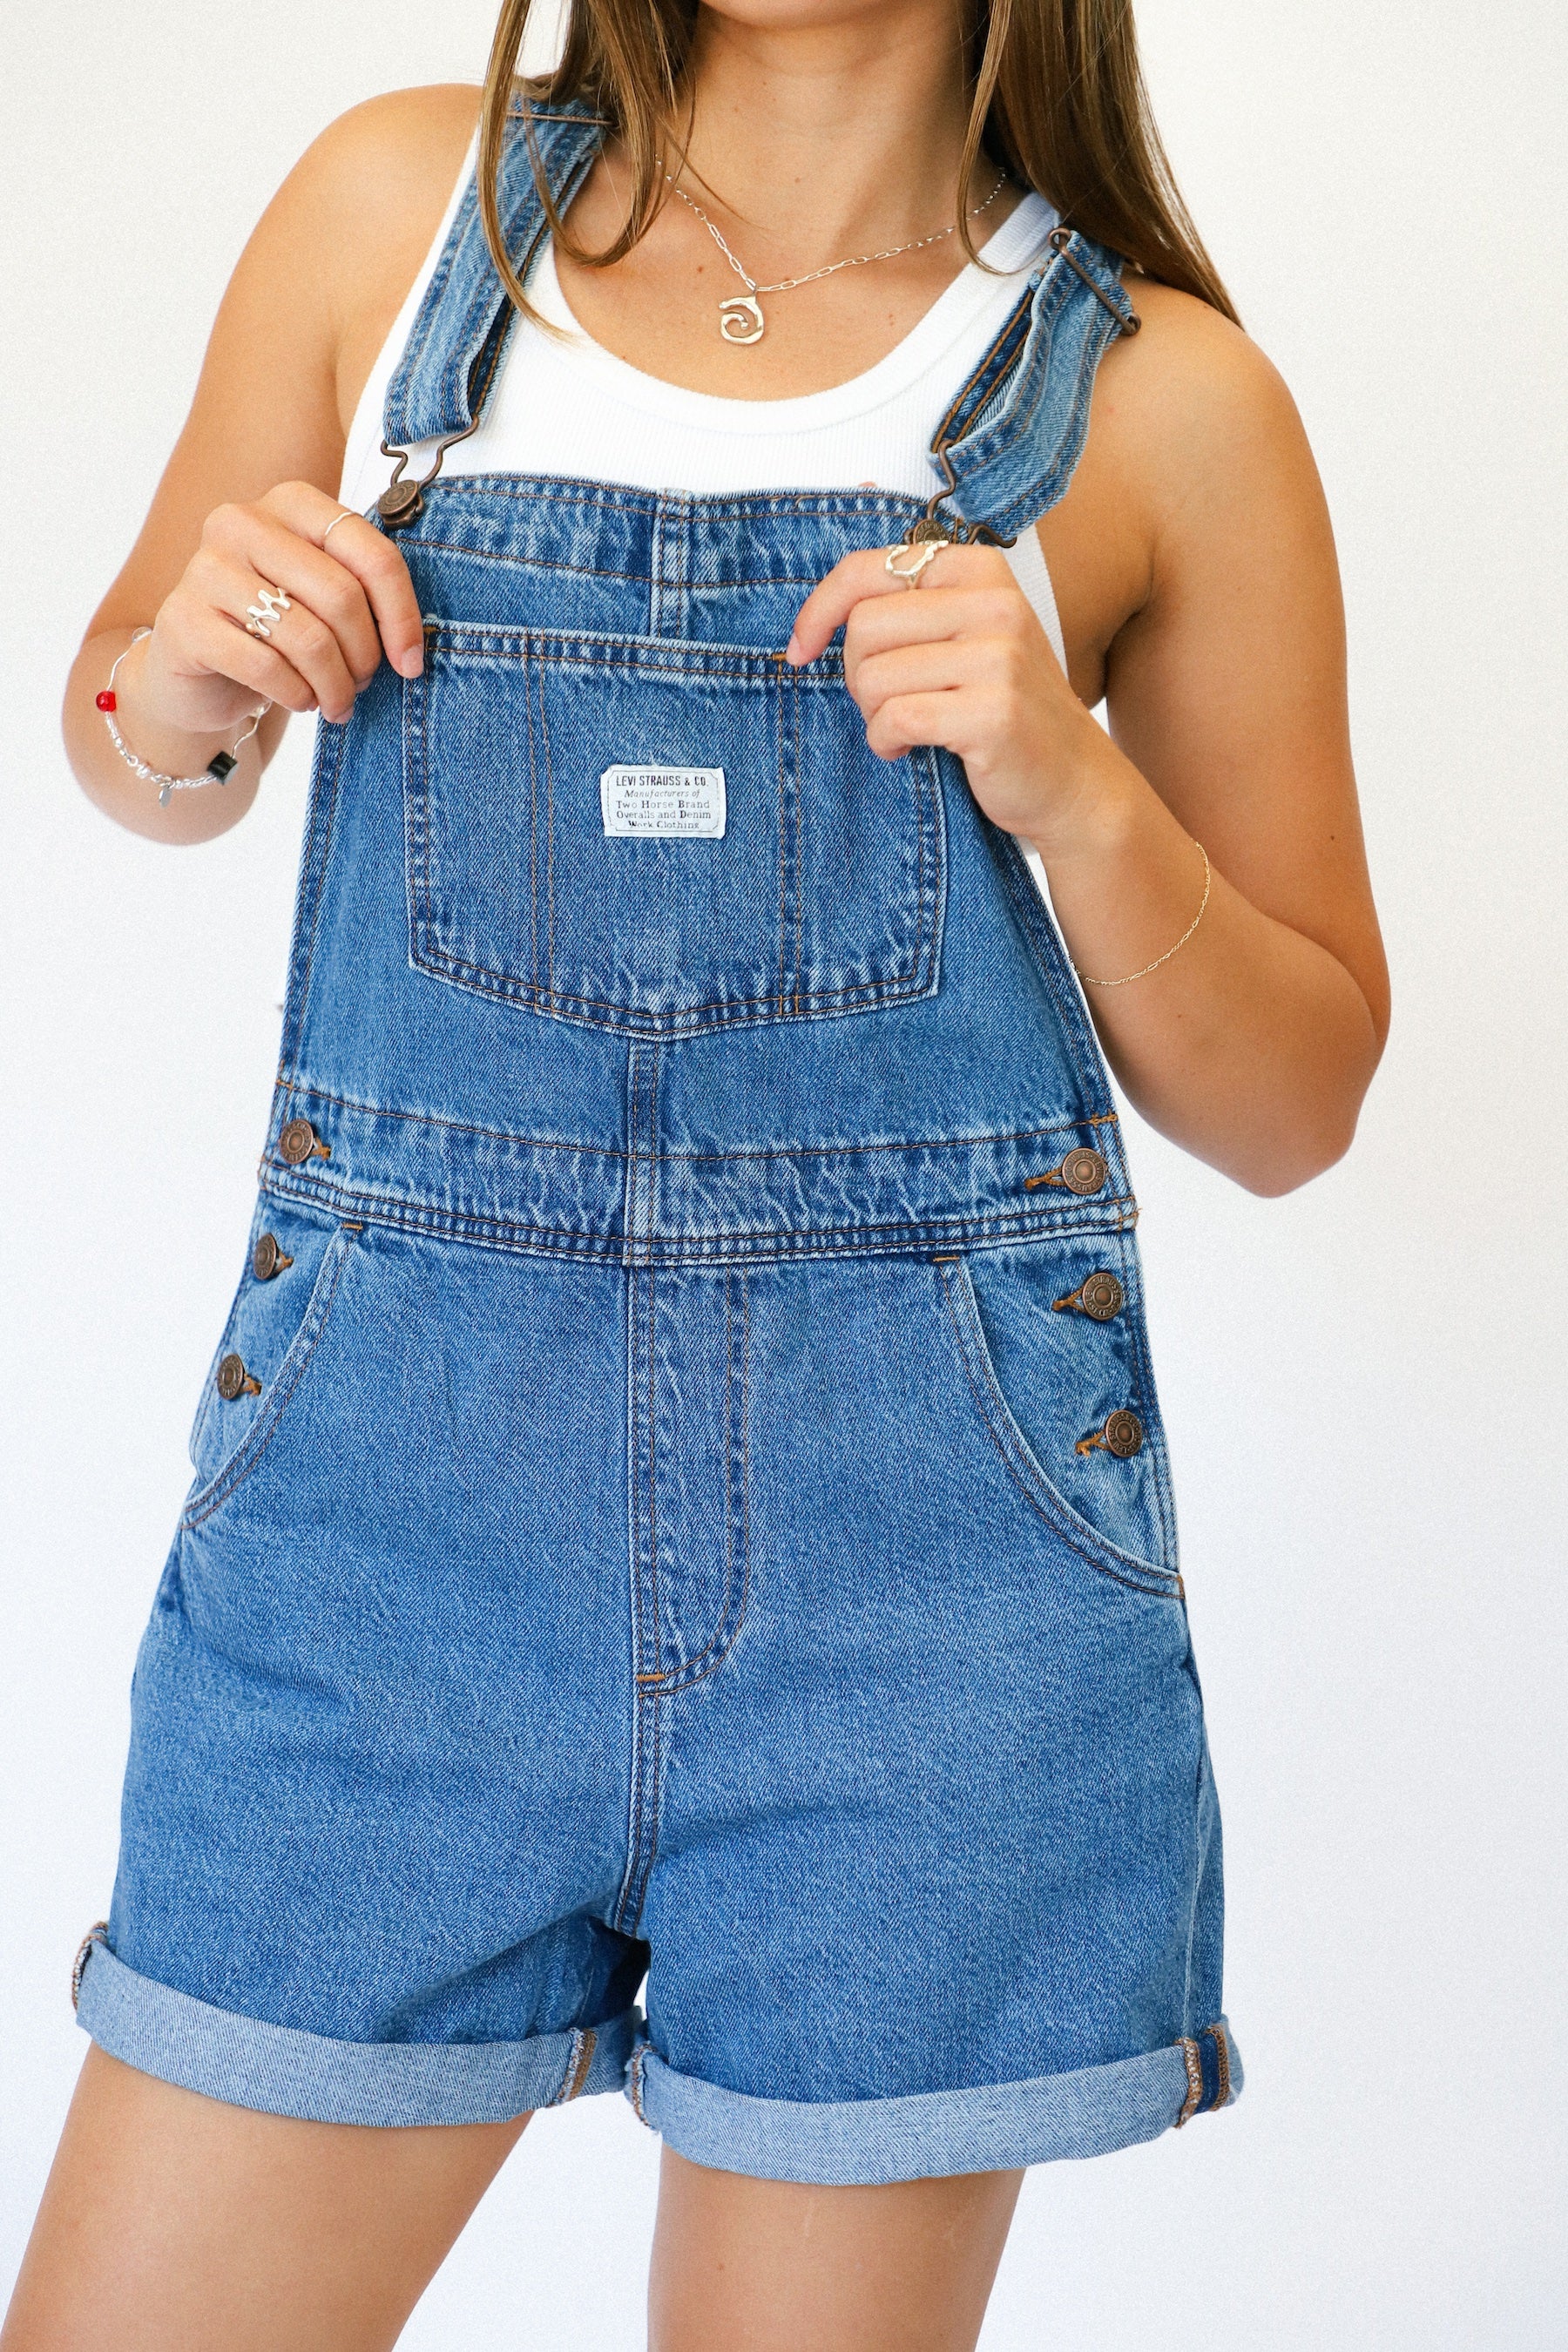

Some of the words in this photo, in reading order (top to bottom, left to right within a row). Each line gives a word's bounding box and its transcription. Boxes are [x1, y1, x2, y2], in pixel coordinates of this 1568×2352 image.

[616, 775, 636, 787] LEVI
[639, 775, 681, 787] STRAUSS
[685, 777, 690, 786] &
[625, 789, 689, 799] Manufacturers
[692, 789, 701, 798] of
[616, 801, 638, 809] Two
[641, 801, 674, 809] Horse
[678, 800, 710, 808] Brand
[617, 810, 655, 819] Overalls
[658, 810, 676, 819] and
[679, 810, 712, 819] Denim
[628, 820, 653, 828] Work
[656, 821, 700, 829] Clothing
